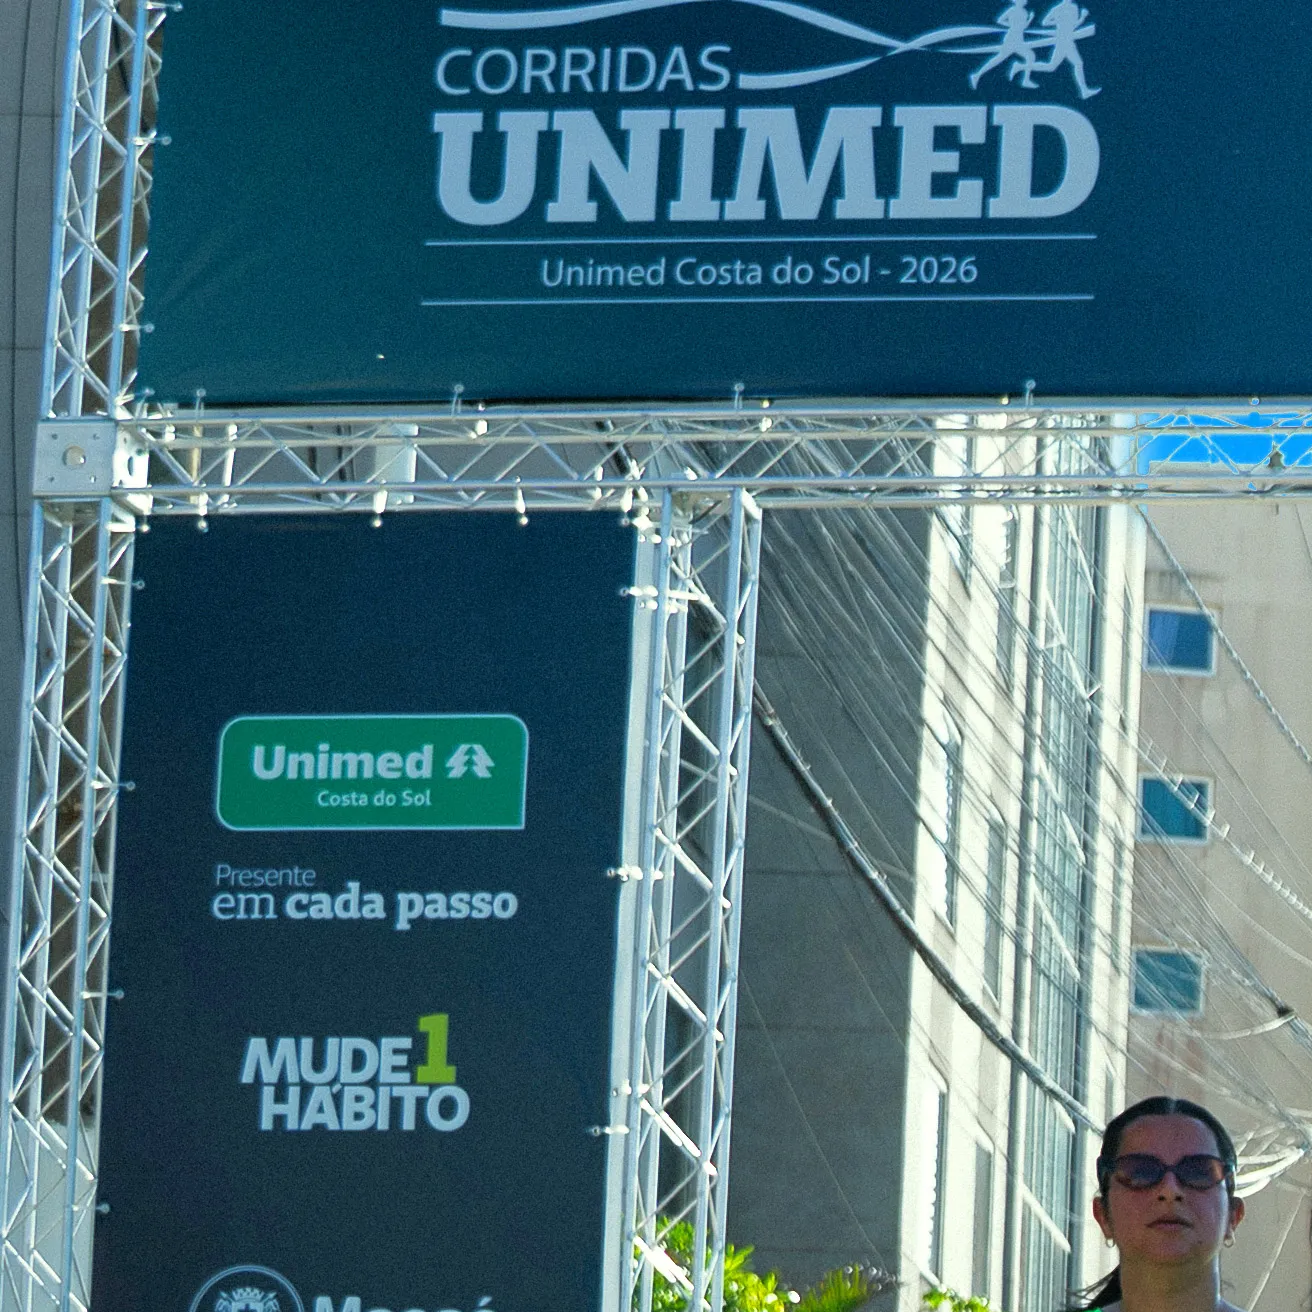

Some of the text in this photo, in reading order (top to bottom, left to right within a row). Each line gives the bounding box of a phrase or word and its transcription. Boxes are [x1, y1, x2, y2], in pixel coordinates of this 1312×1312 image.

[436, 46, 732, 96] CORRIDAS
[433, 104, 1101, 226] UNIMED
[541, 256, 666, 288] Unimed
[674, 257, 764, 287] Costa
[771, 256, 814, 287] do
[822, 255, 872, 286] Sol
[900, 256, 979, 286] 2026
[252, 743, 434, 780] Unimed
[317, 789, 432, 807] Costa do Sol
[215, 864, 317, 887] Presente
[212, 882, 518, 930] em cada passo
[241, 1013, 457, 1084] MUDE 1
[260, 1082, 470, 1131] HÁBITO
